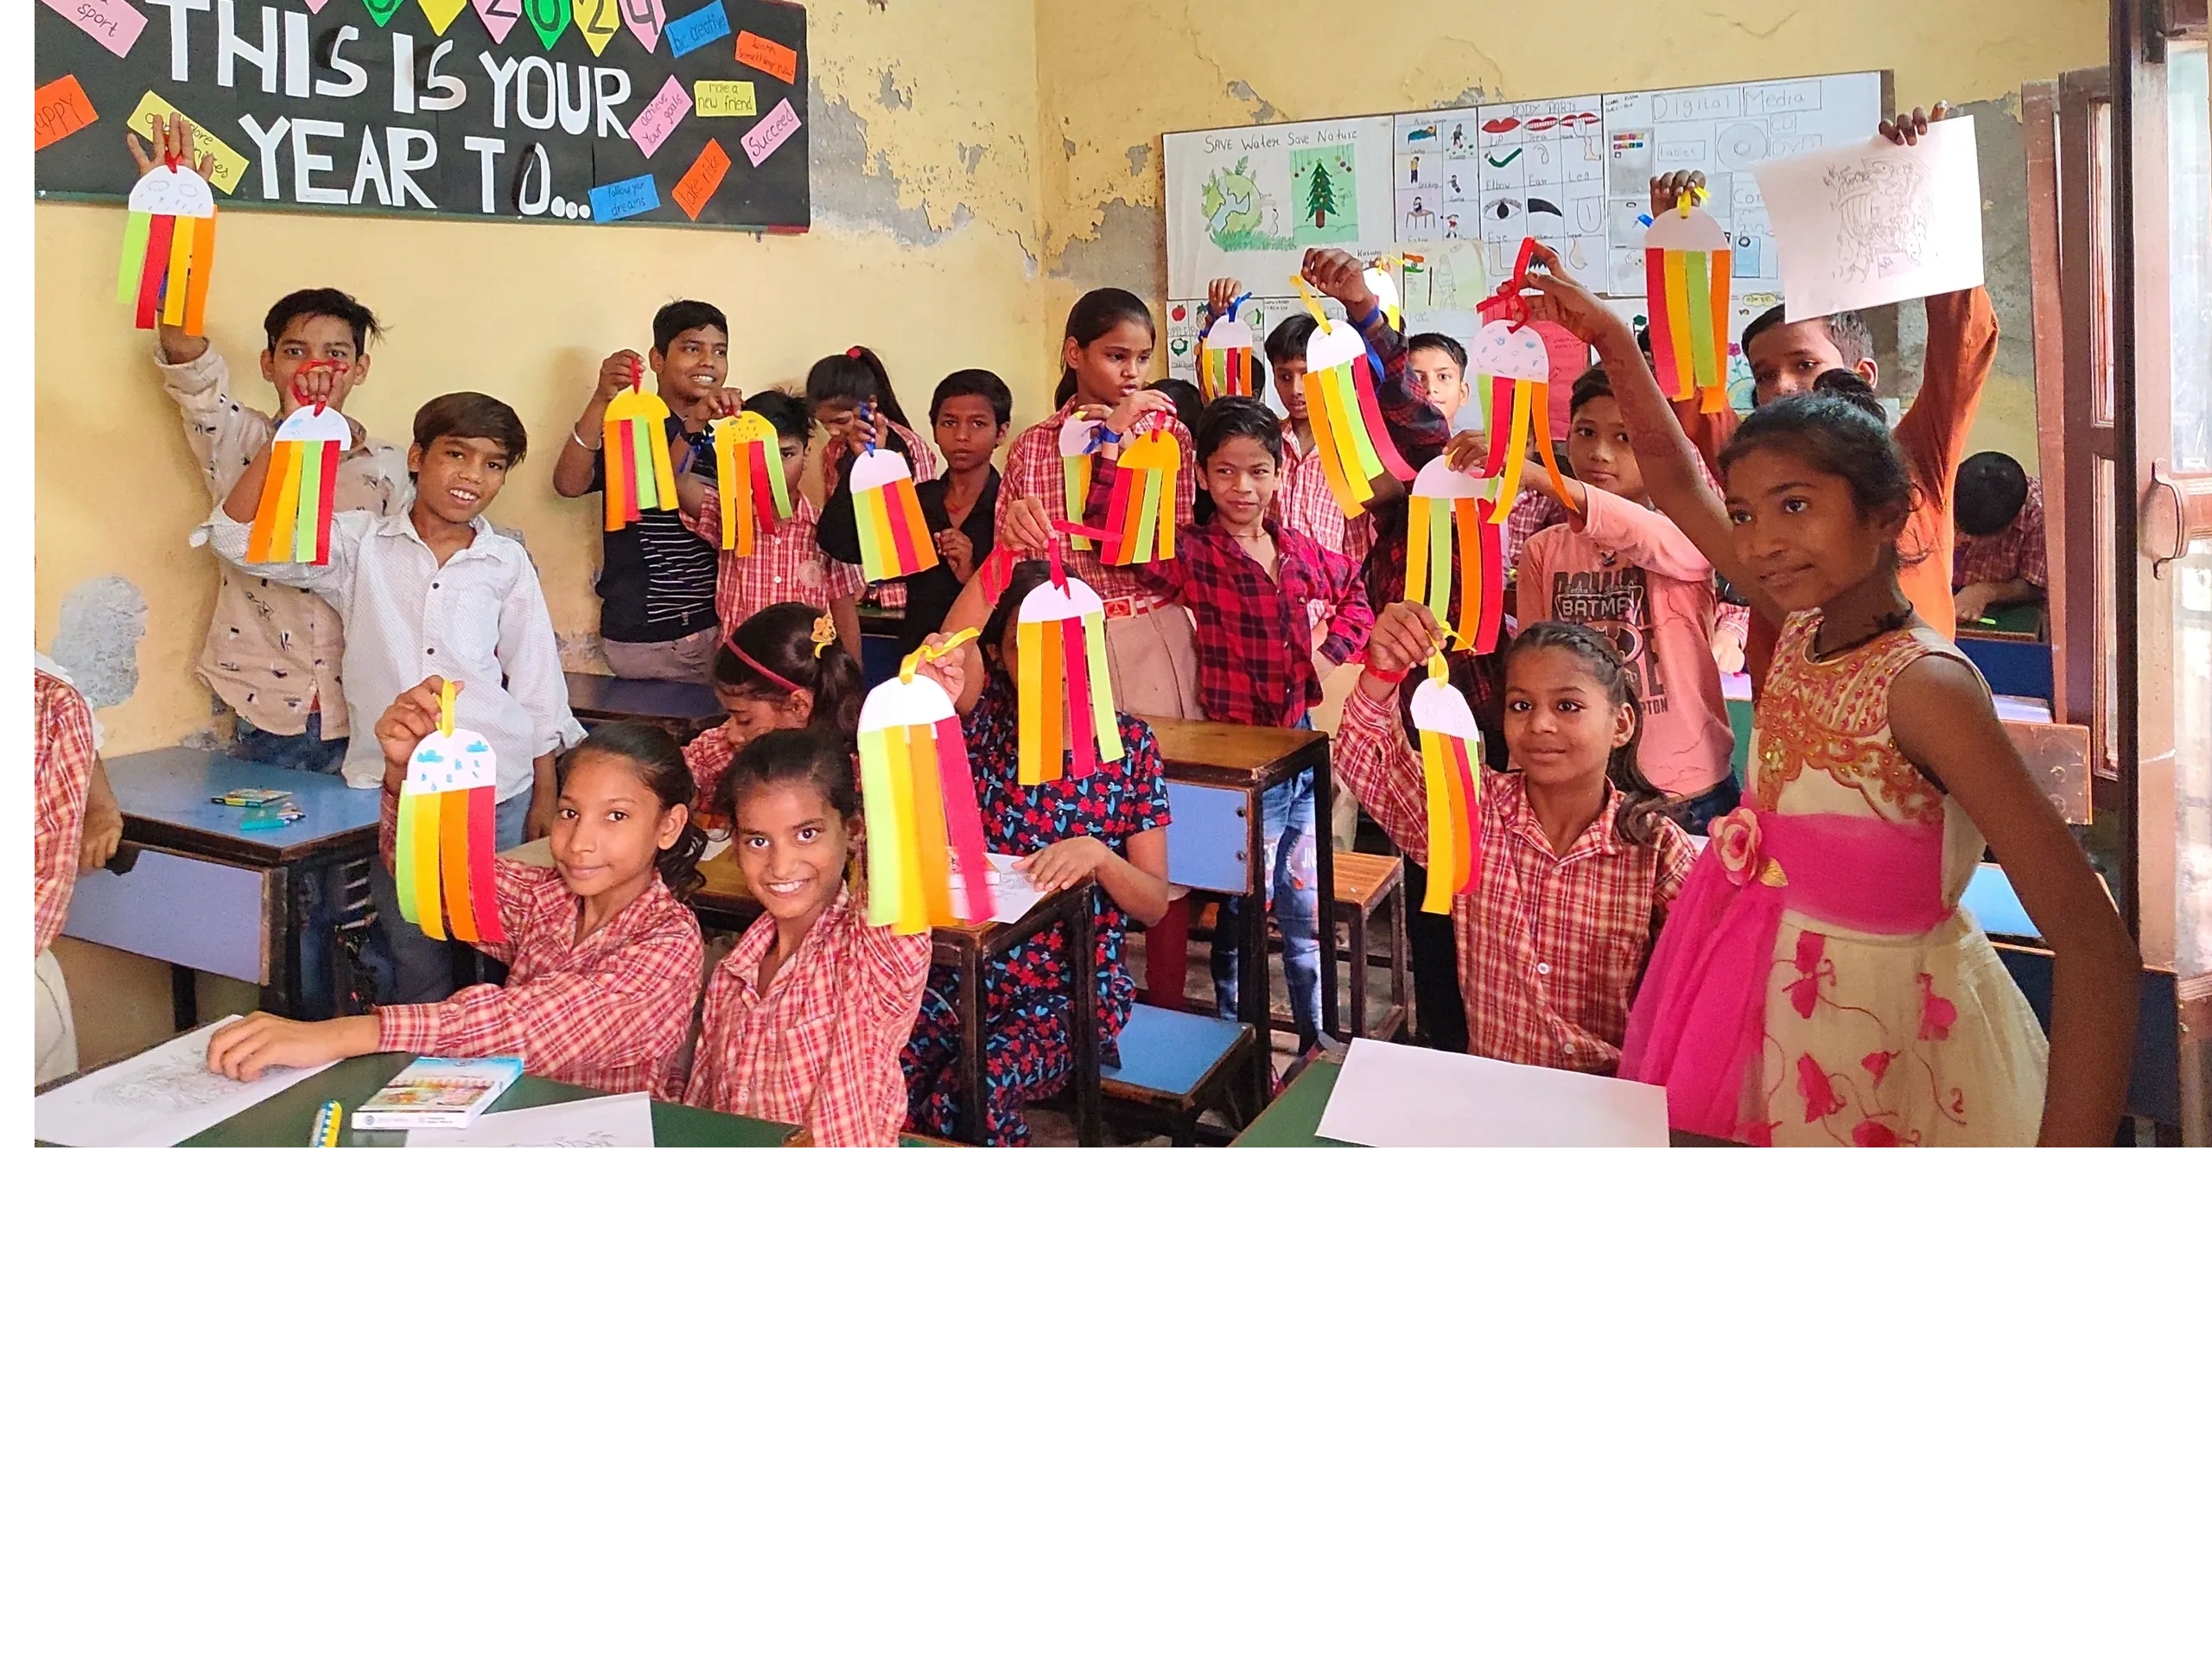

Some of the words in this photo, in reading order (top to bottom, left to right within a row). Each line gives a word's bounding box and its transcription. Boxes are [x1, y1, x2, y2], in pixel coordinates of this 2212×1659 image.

[76, 3, 118, 37] sport
[145, 0, 368, 98] THIS
[393, 32, 467, 113] IS
[478, 50, 631, 139] YOUR
[664, 93, 683, 125] goals
[697, 97, 718, 110] new
[724, 95, 753, 111] friend
[1512, 104, 1541, 118] BODY
[1653, 96, 1729, 120] Digital
[1745, 89, 1804, 113] Media
[1204, 135, 1233, 154] SAVE
[1241, 134, 1281, 151] Water
[1287, 134, 1310, 146] Save
[1317, 129, 1358, 143] Nature
[238, 113, 437, 208] YEAR
[1485, 179, 1510, 190] Elbow
[611, 196, 646, 216] dreams
